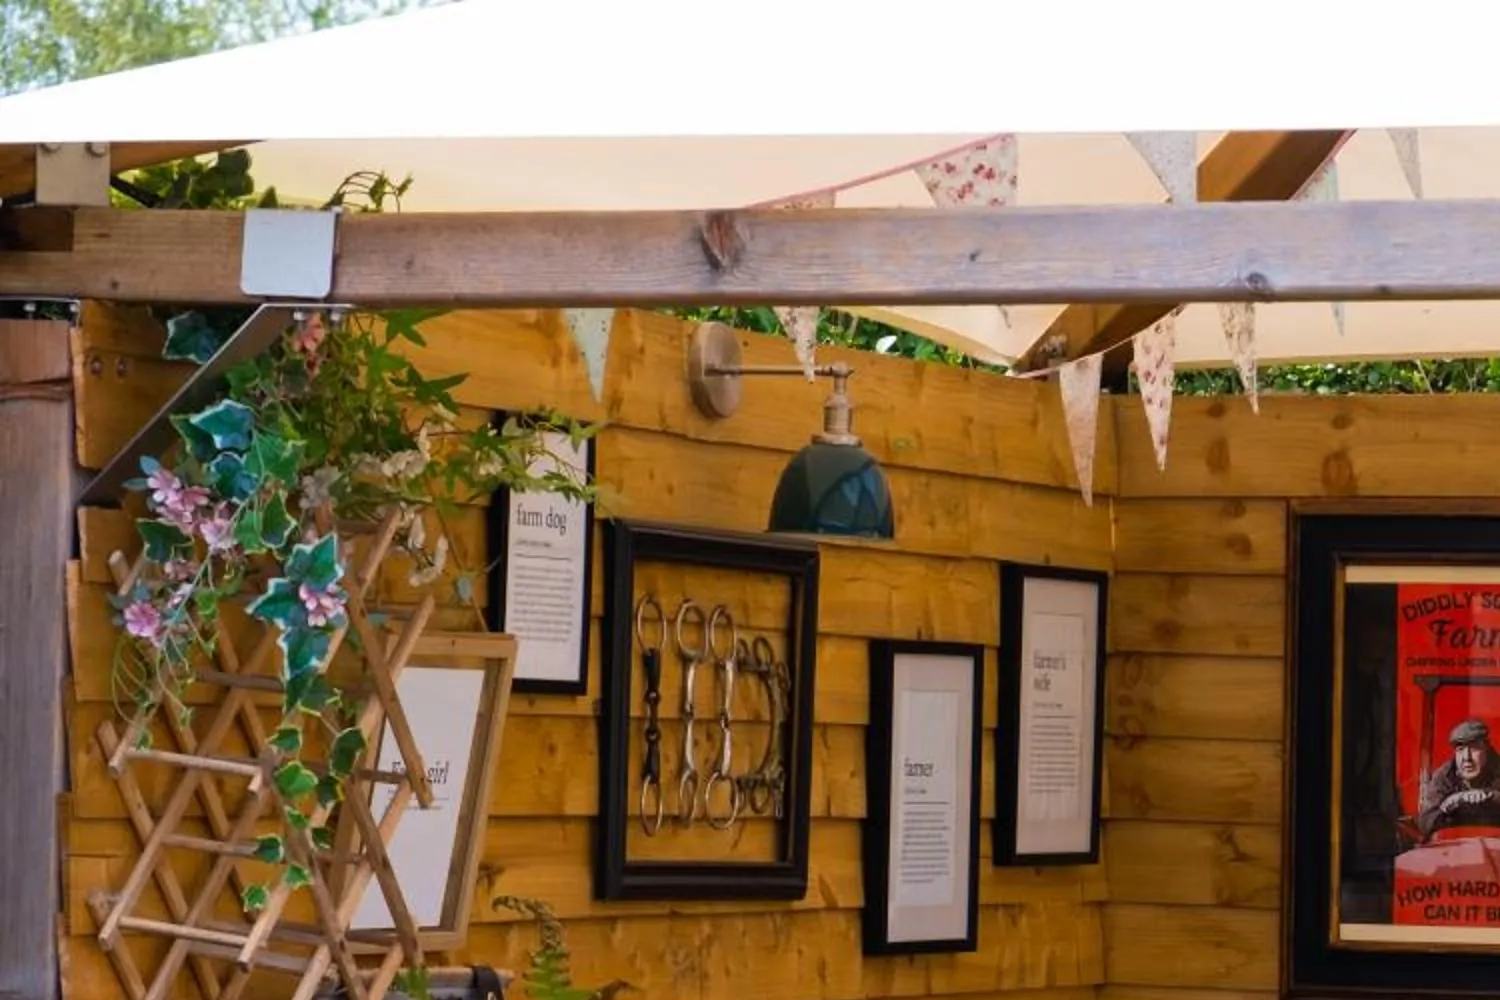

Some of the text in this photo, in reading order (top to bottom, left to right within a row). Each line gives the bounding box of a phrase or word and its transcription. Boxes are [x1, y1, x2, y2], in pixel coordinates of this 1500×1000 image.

[517, 502, 567, 536] farm dog
[1402, 591, 1474, 622] DIDDLY
[1397, 882, 1442, 907] HOW
[1449, 880, 1500, 898] HARD
[1423, 904, 1461, 921] CAN
[1465, 905, 1479, 921] IT
